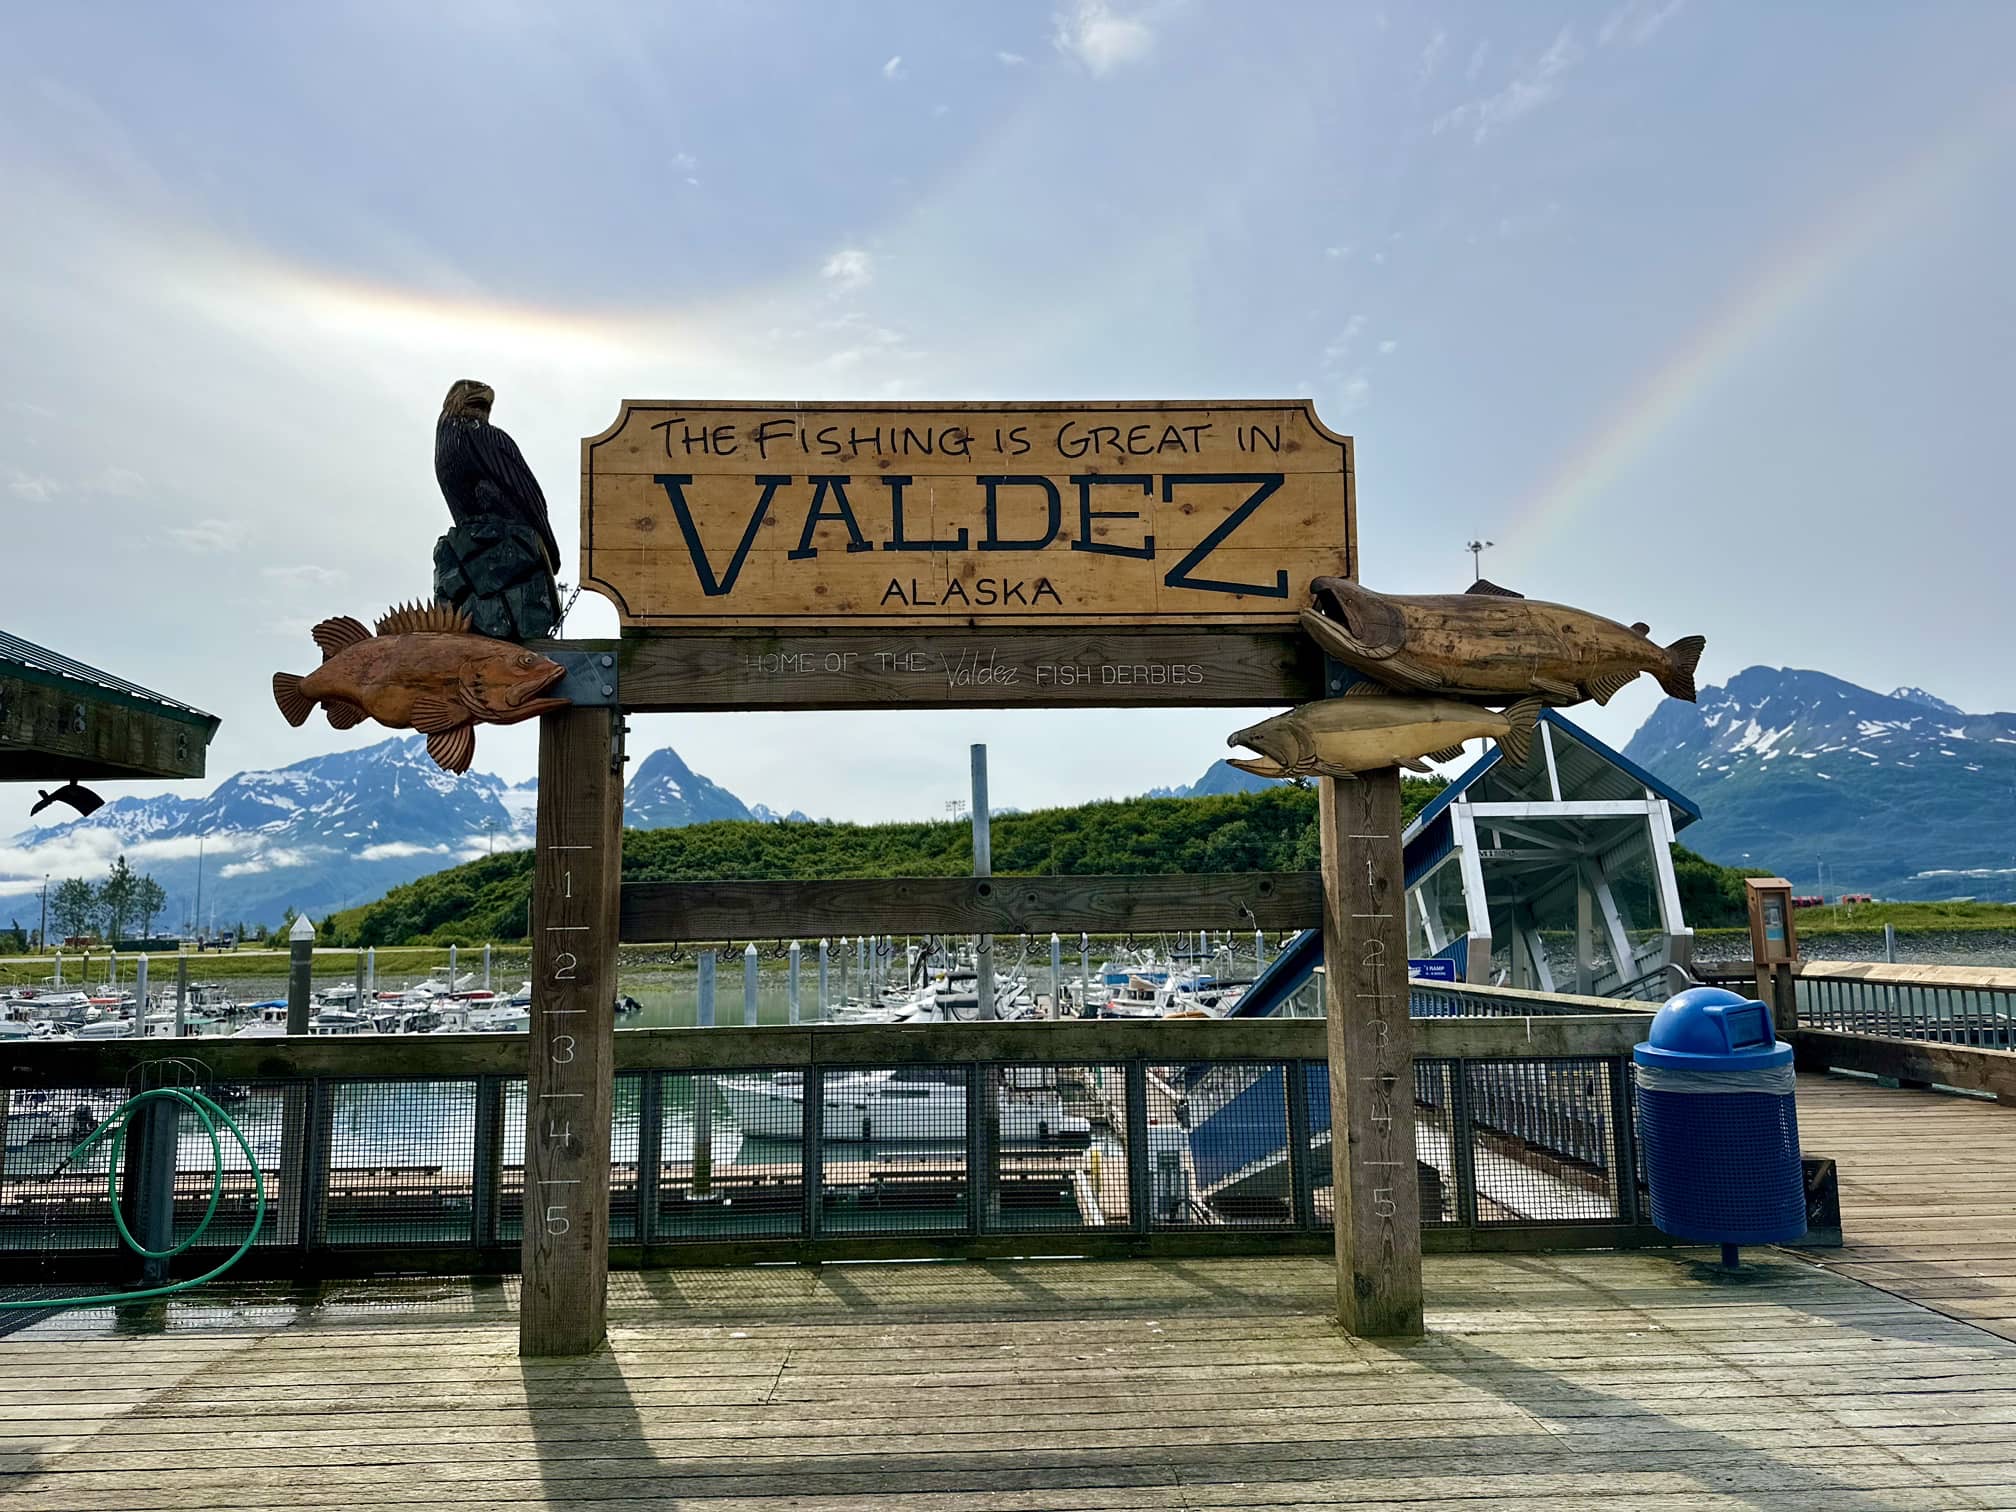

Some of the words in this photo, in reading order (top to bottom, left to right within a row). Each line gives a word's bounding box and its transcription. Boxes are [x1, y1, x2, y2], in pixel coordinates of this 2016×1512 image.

[650, 418, 738, 459] THE
[754, 418, 975, 460] FISHING
[994, 426, 1032, 455] IS
[1057, 421, 1212, 458] GREAT
[1237, 424, 1281, 453] IN
[653, 473, 1289, 599] VALDEZ
[880, 577, 1063, 606] ALASKA
[745, 652, 816, 673] HOME
[874, 652, 927, 672] THE
[939, 647, 1020, 689] Valdez
[1036, 664, 1091, 685] FISH
[1101, 664, 1204, 685] DERBIES
[564, 871, 572, 898] 1
[1366, 860, 1375, 886] 1
[554, 952, 577, 980] 2
[1362, 939, 1385, 966] 2
[1367, 1019, 1389, 1048] 3
[552, 1035, 575, 1064] 3
[1371, 1103, 1393, 1131] 4
[550, 1119, 572, 1147] 4
[1373, 1187, 1396, 1217] 5
[546, 1206, 570, 1235] 5
